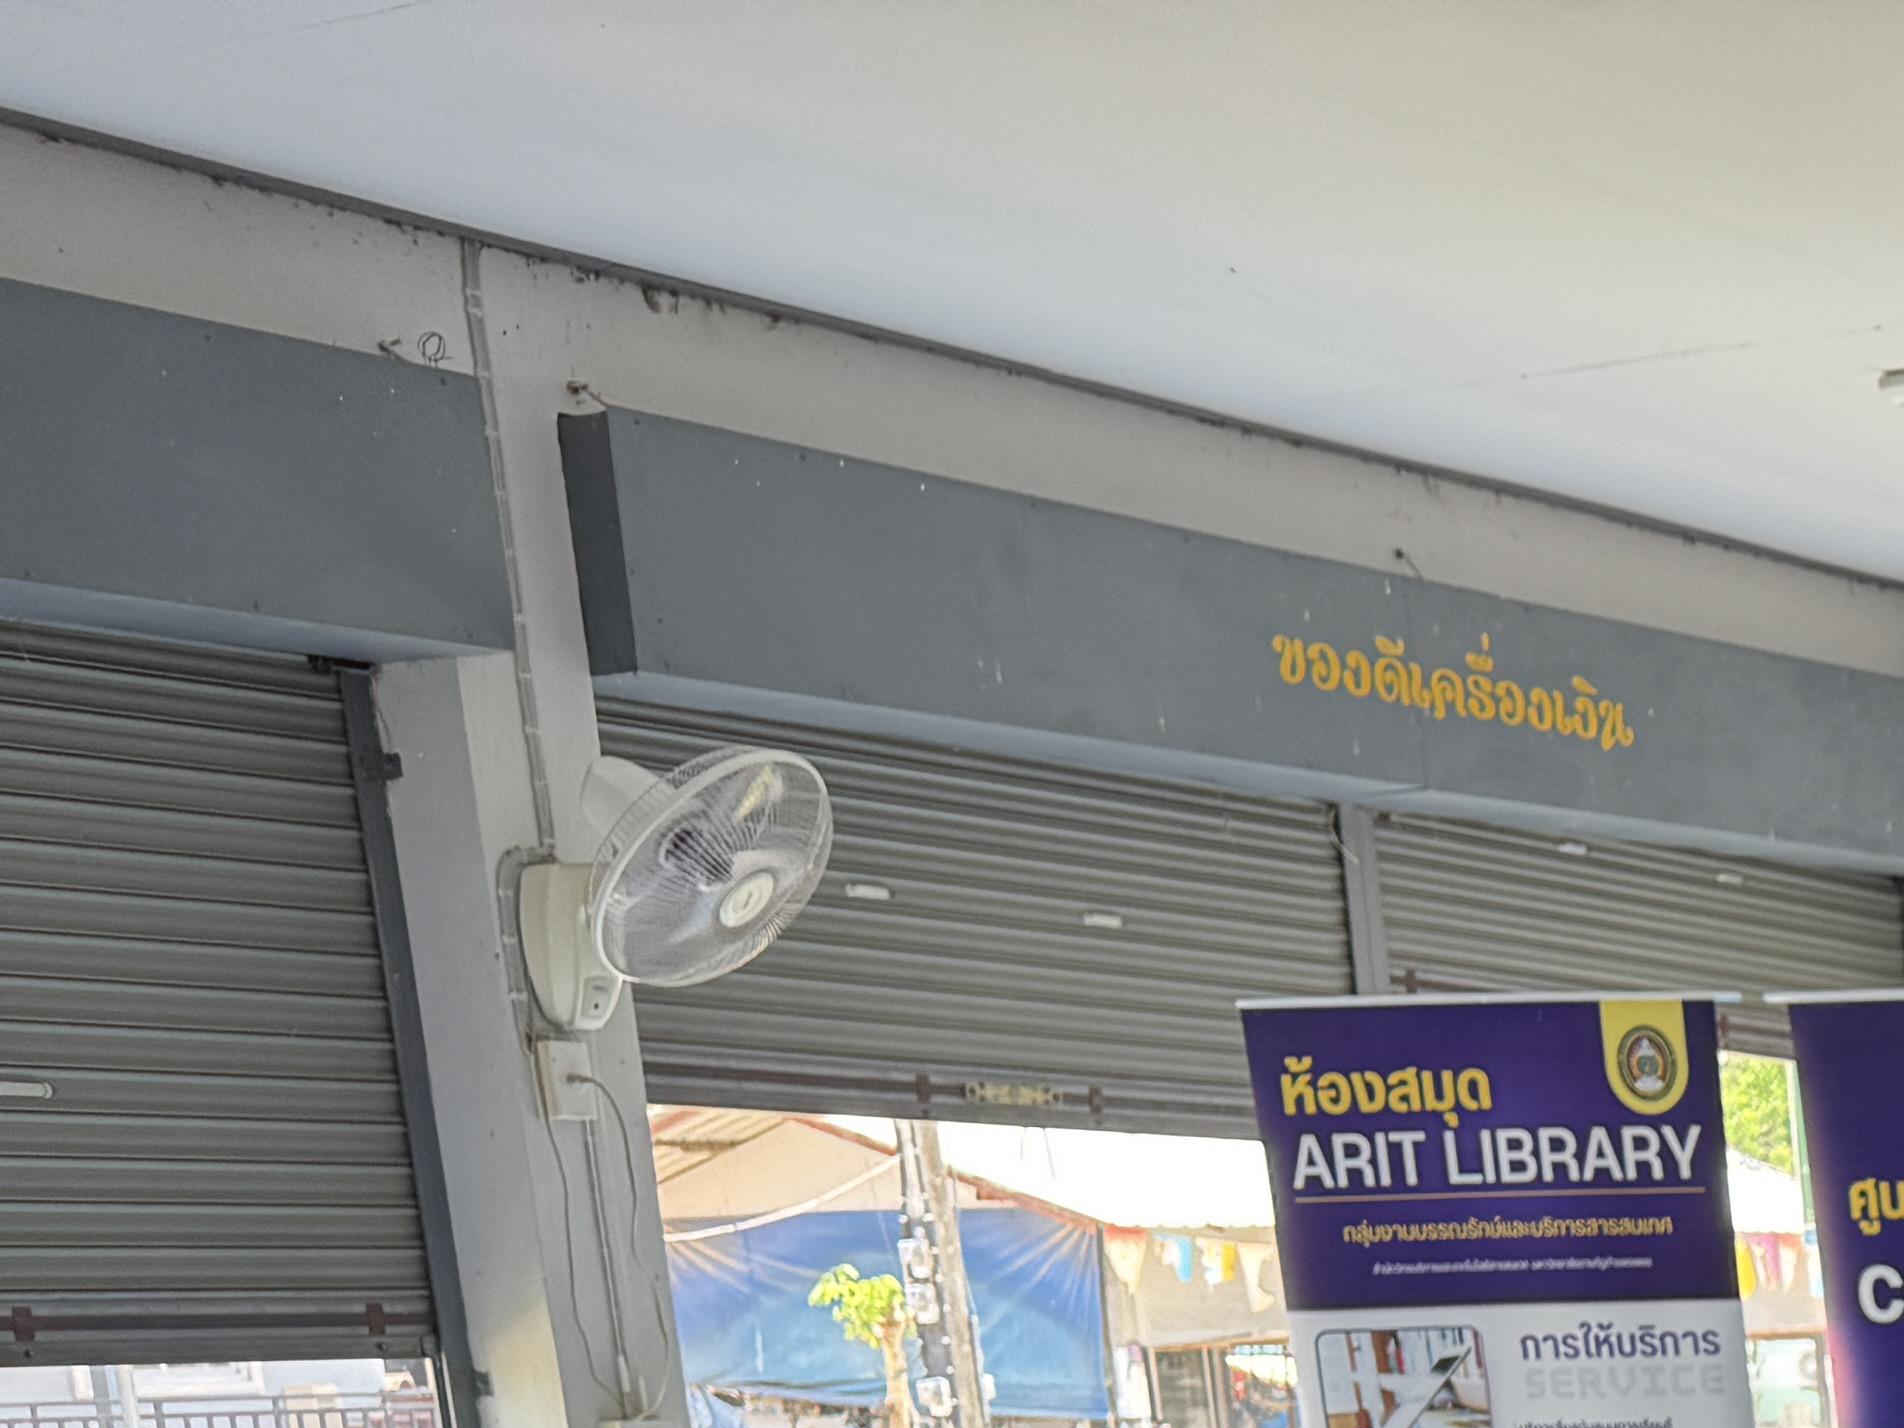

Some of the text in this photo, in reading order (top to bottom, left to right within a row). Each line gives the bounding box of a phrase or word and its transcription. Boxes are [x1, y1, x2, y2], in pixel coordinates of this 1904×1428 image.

[1271, 631, 1635, 752] ของดีเครื่องเงิน
[1280, 1055, 1492, 1128] ห้องสมุด
[1293, 1123, 1703, 1191] ARIT LIBRARY
[1519, 1320, 1721, 1361] การให้บริการ
[1525, 1363, 1726, 1400] SERVICE
